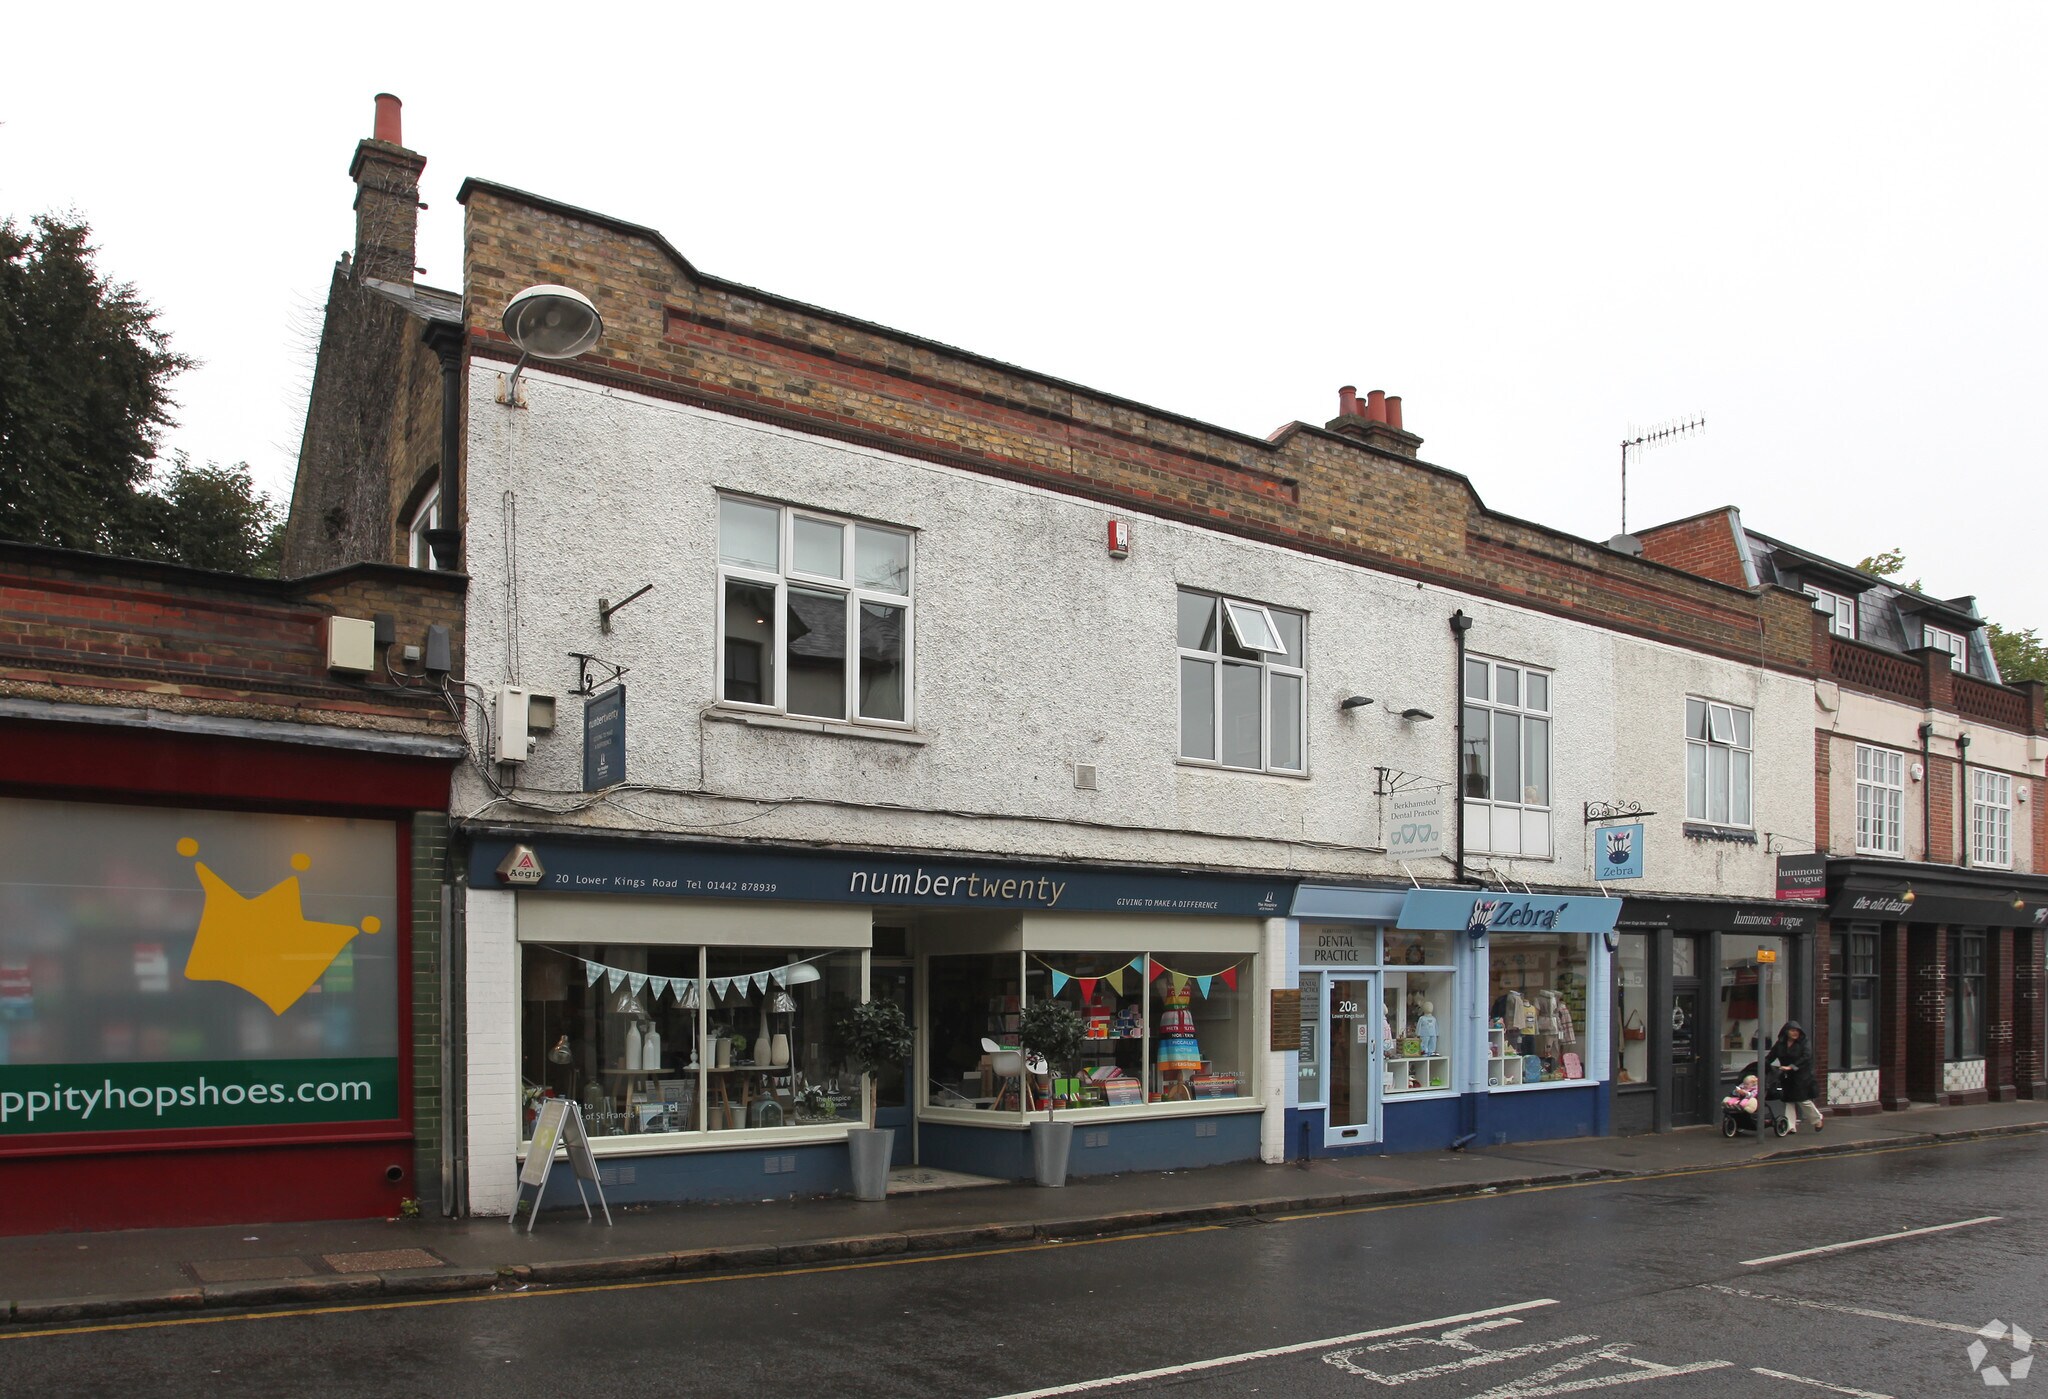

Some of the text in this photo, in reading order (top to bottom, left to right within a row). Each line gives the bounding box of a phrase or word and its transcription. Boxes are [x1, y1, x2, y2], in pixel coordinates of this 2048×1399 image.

[1394, 798, 1437, 810] Berkhamsted
[1391, 808, 1440, 820] Dental Practice
[508, 868, 542, 880] Aegis
[1603, 866, 1634, 877] Zebra
[1778, 868, 1823, 877] luminous
[556, 874, 777, 892] 20 Lower Kings Road Tel 01442 878939
[1793, 876, 1823, 885] vogue
[849, 868, 1066, 907] numbertwenty
[1116, 897, 1143, 907] GIVING
[1144, 899, 1153, 907] TO
[1153, 899, 1171, 908] MAKE
[1178, 900, 1218, 909] DIFFERENCE
[1853, 896, 1912, 915] the old dairy
[1494, 901, 1555, 929] Zebra
[1733, 910, 1772, 926] luminous
[1780, 916, 1804, 930] vogue
[1318, 935, 1354, 947] DENTAL
[1314, 949, 1359, 961] PRACTICE
[1339, 1000, 1358, 1012] 20a
[0, 1076, 372, 1123] ppityhopshoes.com
[584, 1102, 594, 1111] to
[585, 1110, 634, 1121] of St Francis
